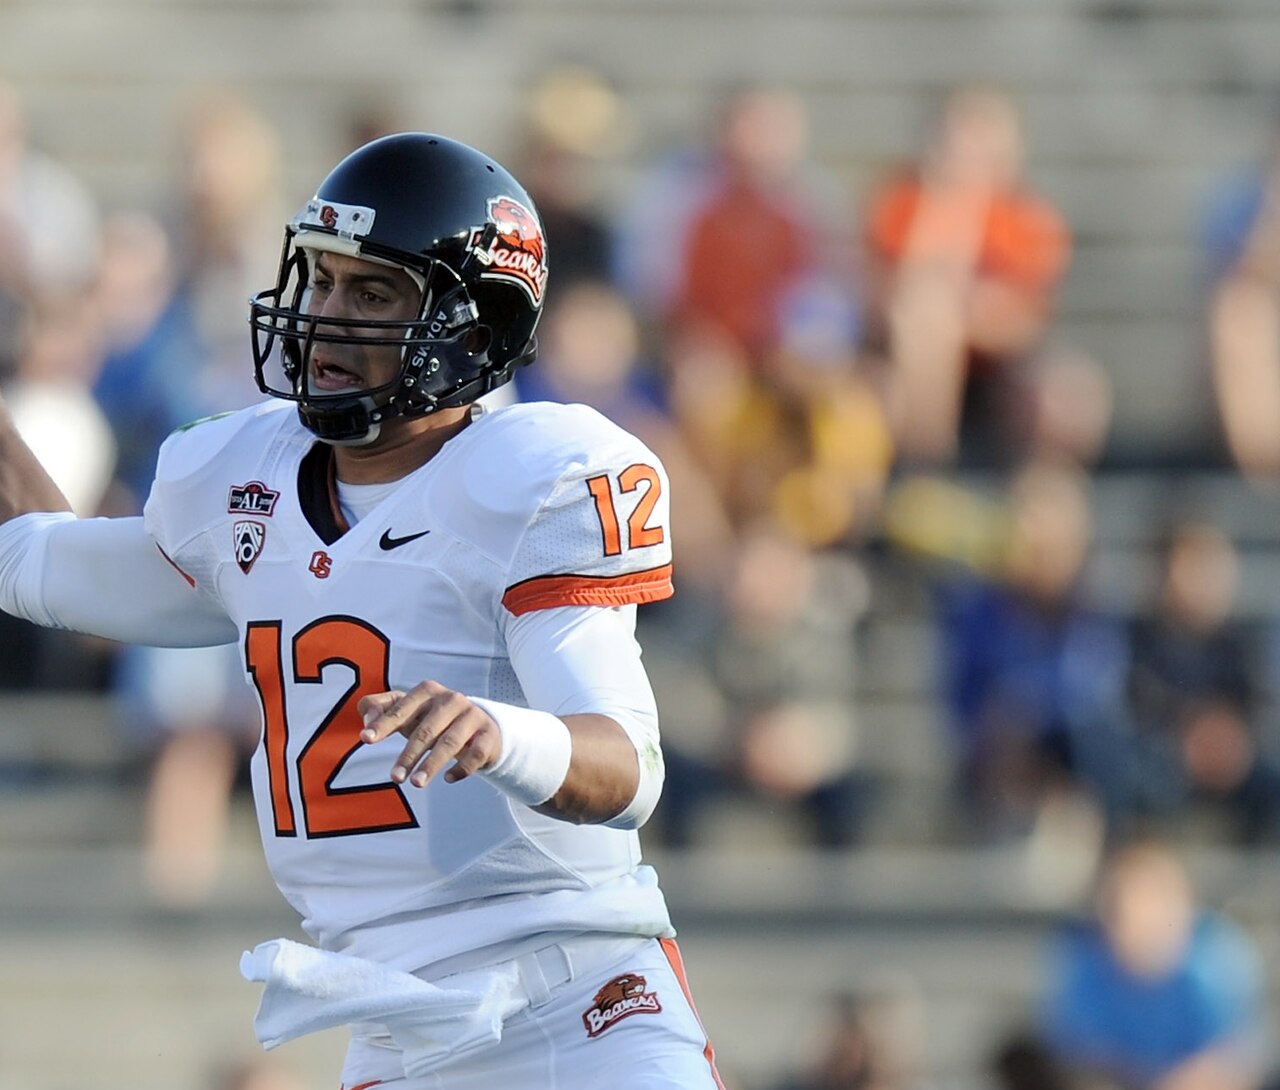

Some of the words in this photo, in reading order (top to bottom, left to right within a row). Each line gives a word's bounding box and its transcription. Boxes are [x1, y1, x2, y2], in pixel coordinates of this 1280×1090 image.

[411, 310, 447, 368] ADAMS
[585, 463, 664, 557] 12
[245, 614, 420, 839] 12
[586, 994, 659, 1033] Beavers
